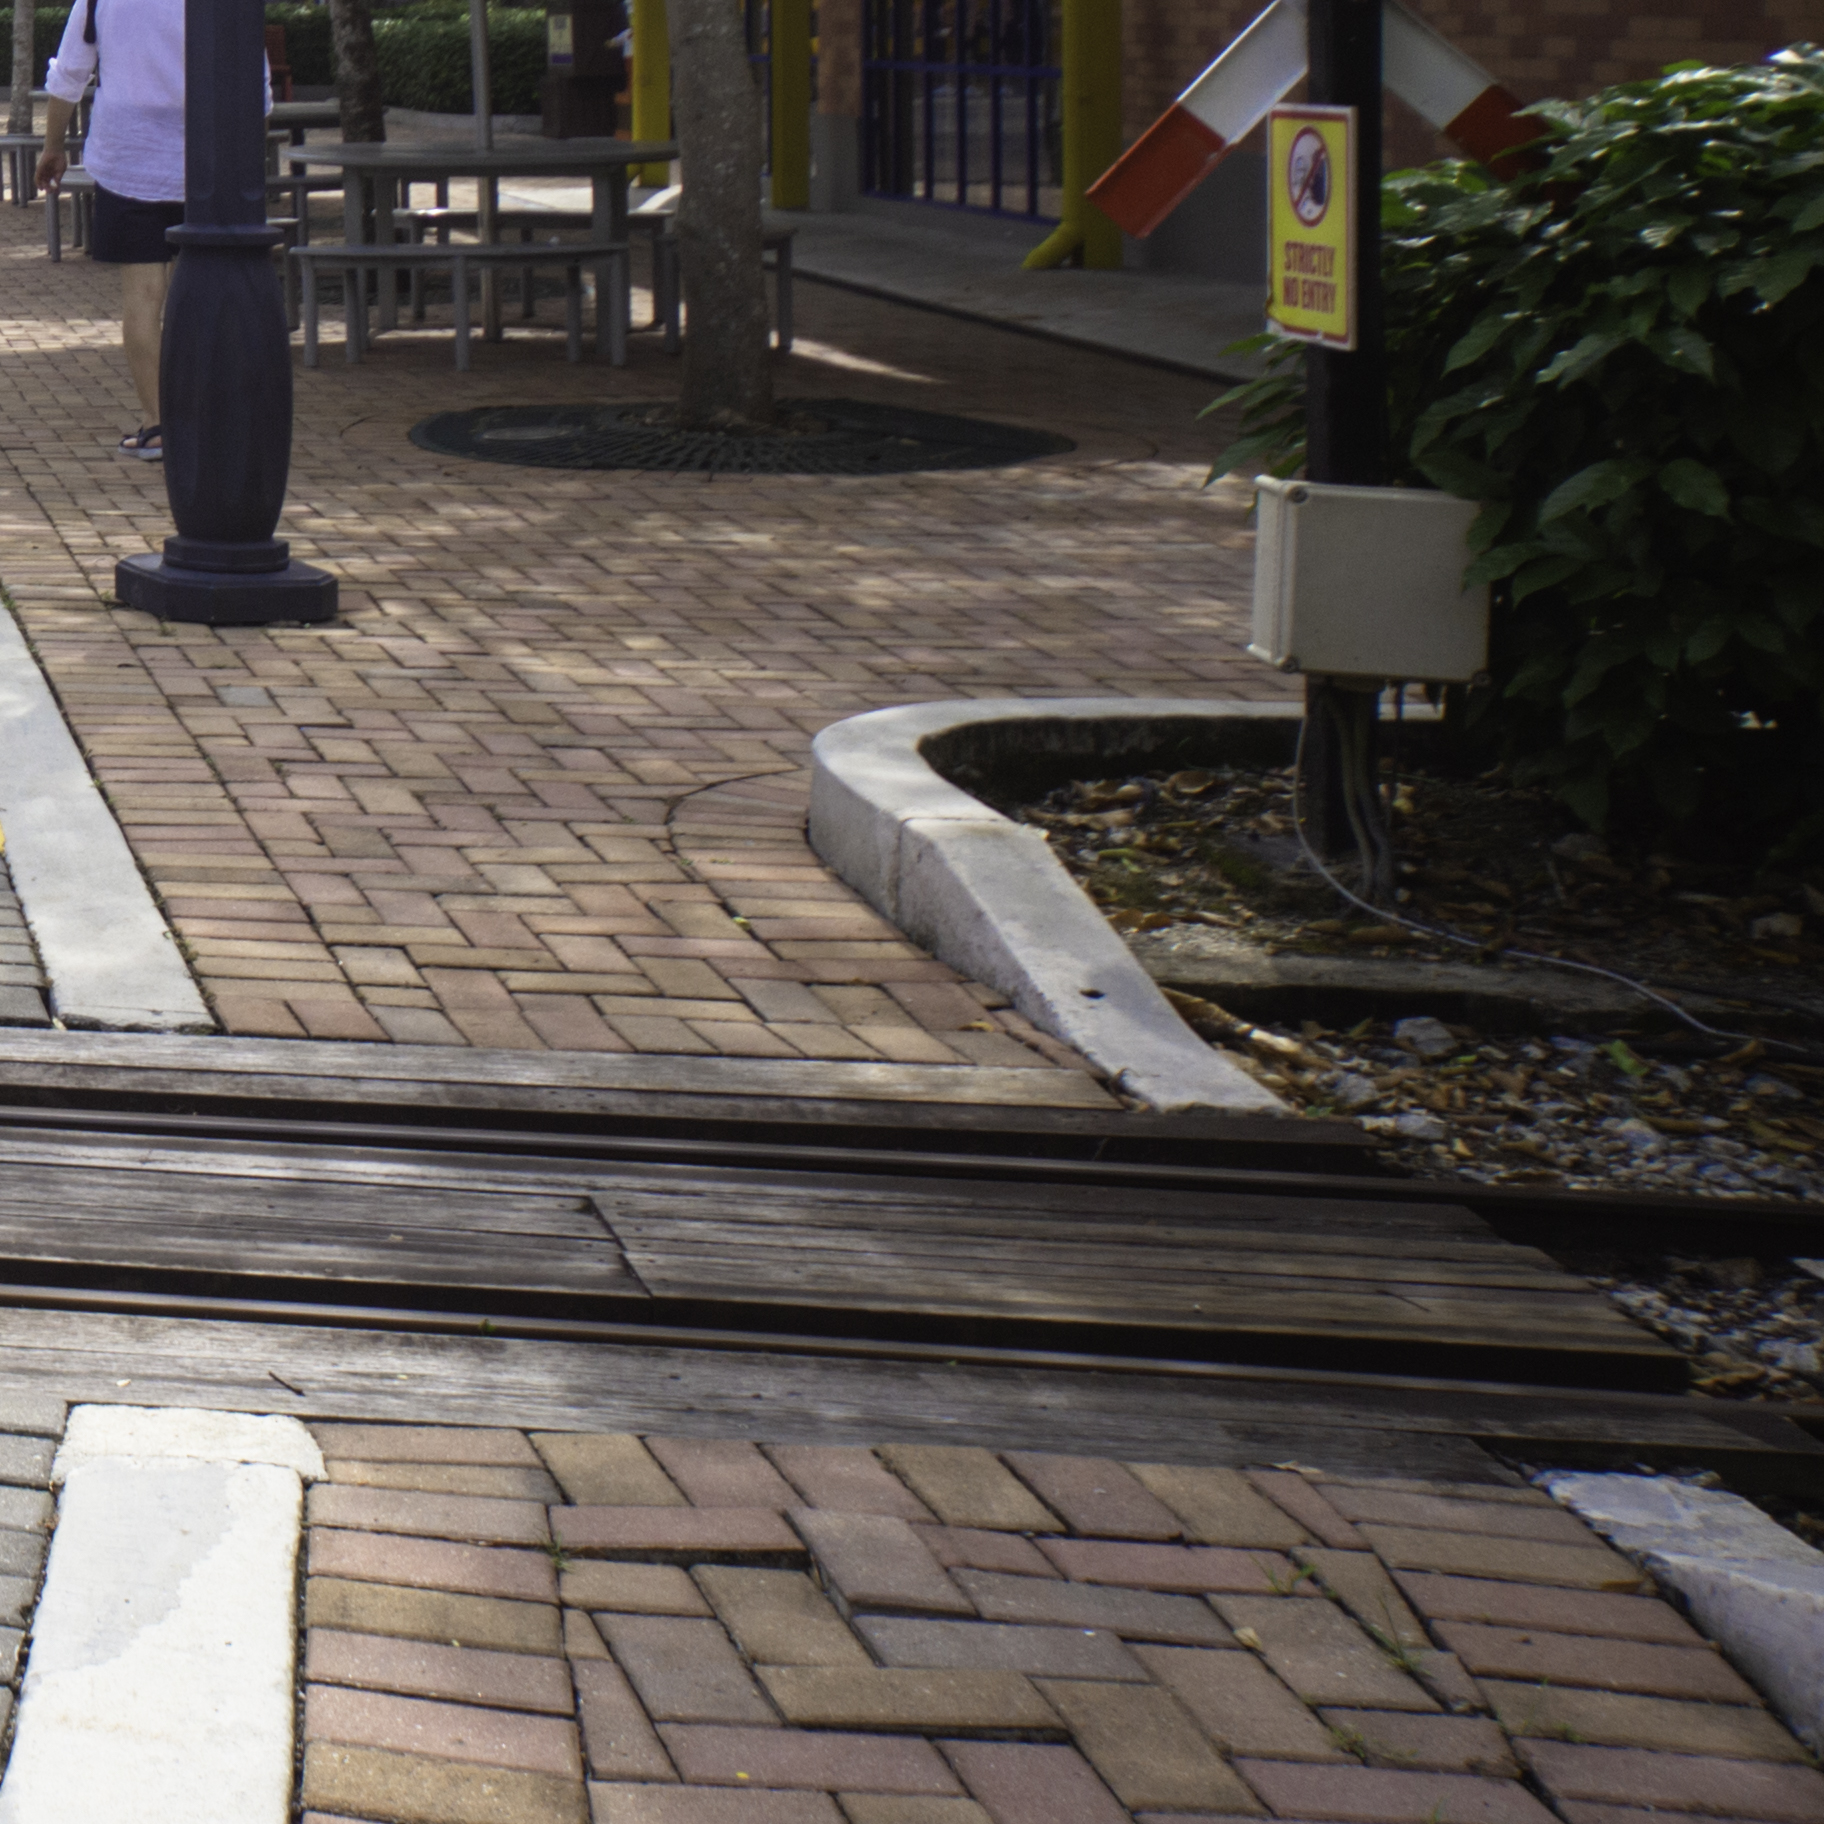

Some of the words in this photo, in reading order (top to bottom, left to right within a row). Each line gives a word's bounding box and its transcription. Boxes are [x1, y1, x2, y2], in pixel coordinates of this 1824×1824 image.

[1284, 240, 1335, 278] STRICTLY
[1282, 275, 1299, 308] NO
[1301, 278, 1337, 314] ENTRY
